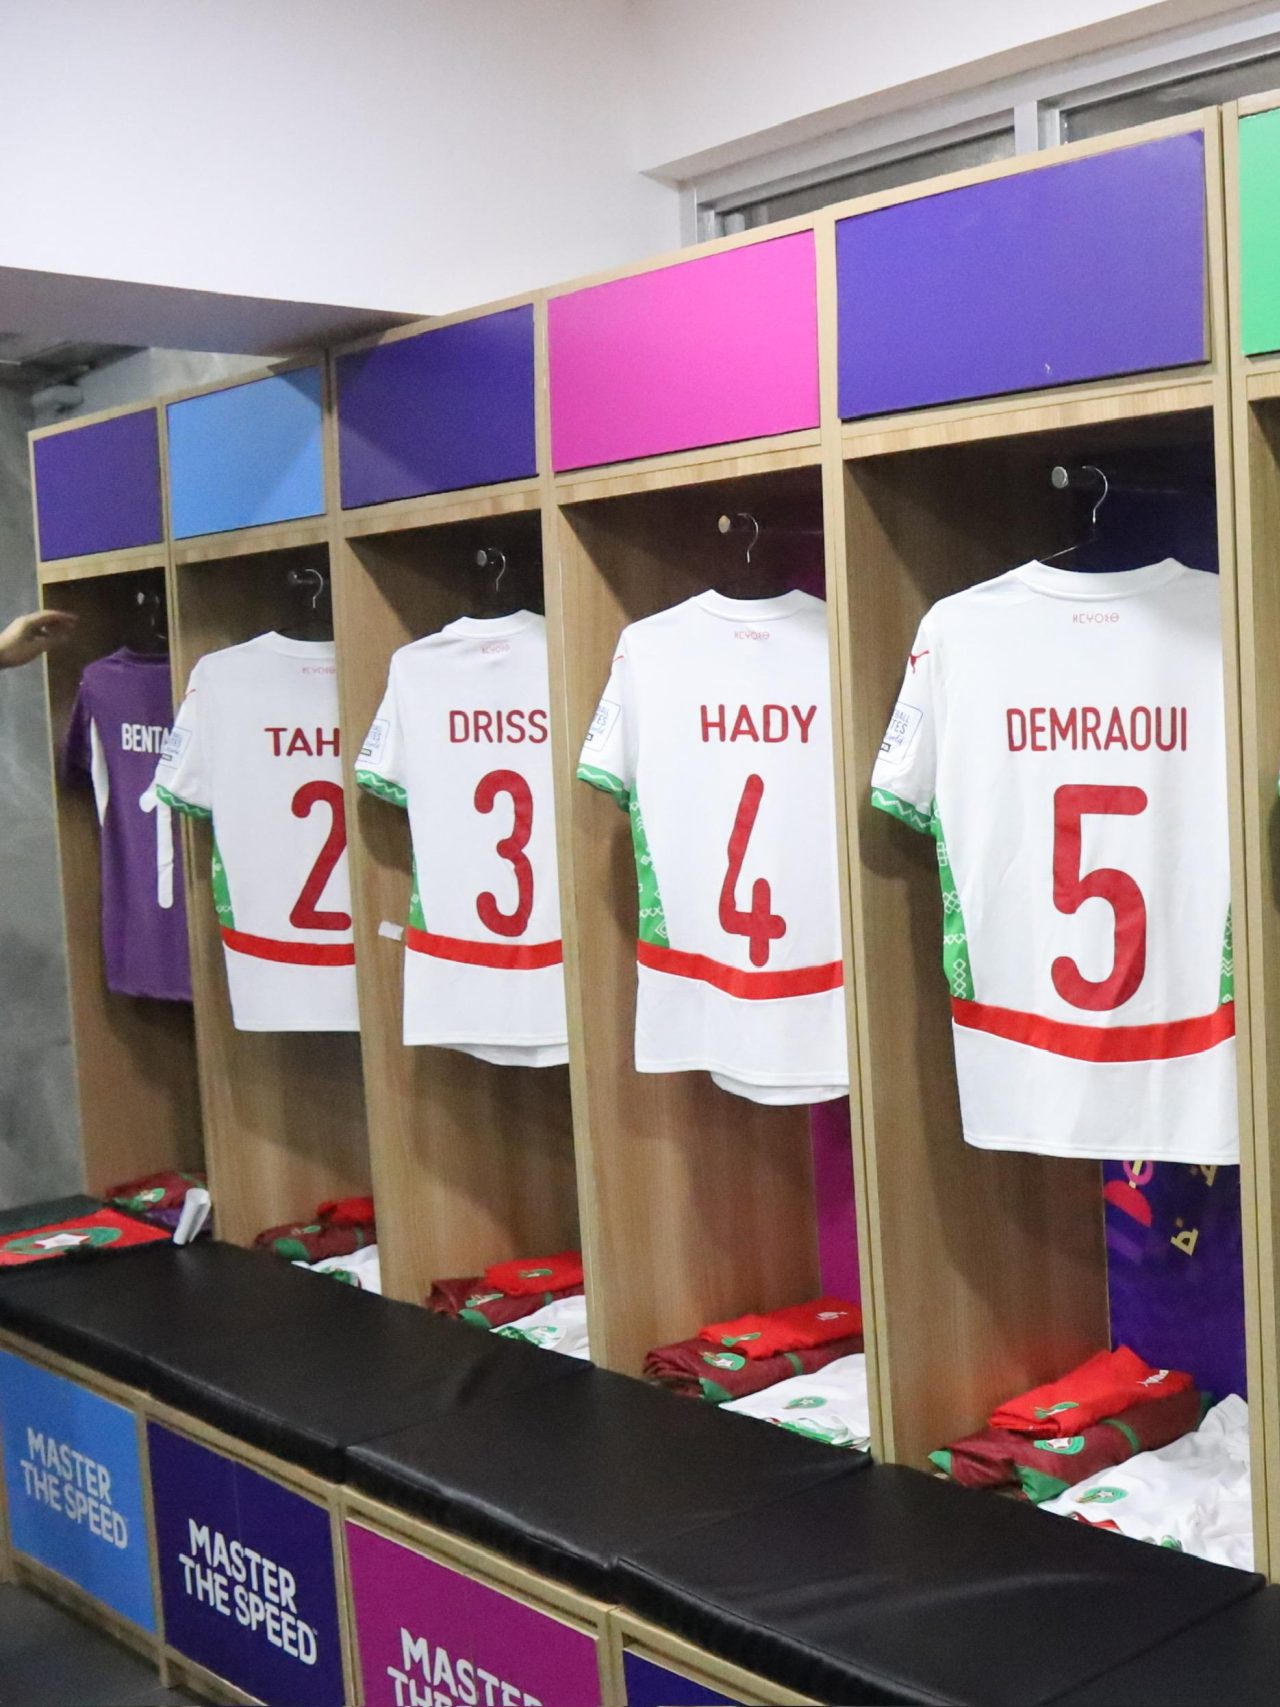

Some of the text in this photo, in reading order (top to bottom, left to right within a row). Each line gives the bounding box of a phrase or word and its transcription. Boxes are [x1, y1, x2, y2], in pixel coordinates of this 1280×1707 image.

[264, 727, 340, 757] TAH
[449, 709, 548, 744] DRISS
[701, 703, 817, 743] HADY
[1007, 706, 1188, 752] DEMRAOUI
[139, 783, 174, 909] 1
[289, 780, 353, 931] 2
[474, 769, 534, 938] 3
[718, 773, 787, 967] 4
[1051, 784, 1148, 1012] 5
[20, 1459, 128, 1549] THE SPEED
[27, 1426, 112, 1505] MASTER
[178, 1553, 317, 1665] THE SPEED
[189, 1518, 297, 1614] MASTER
